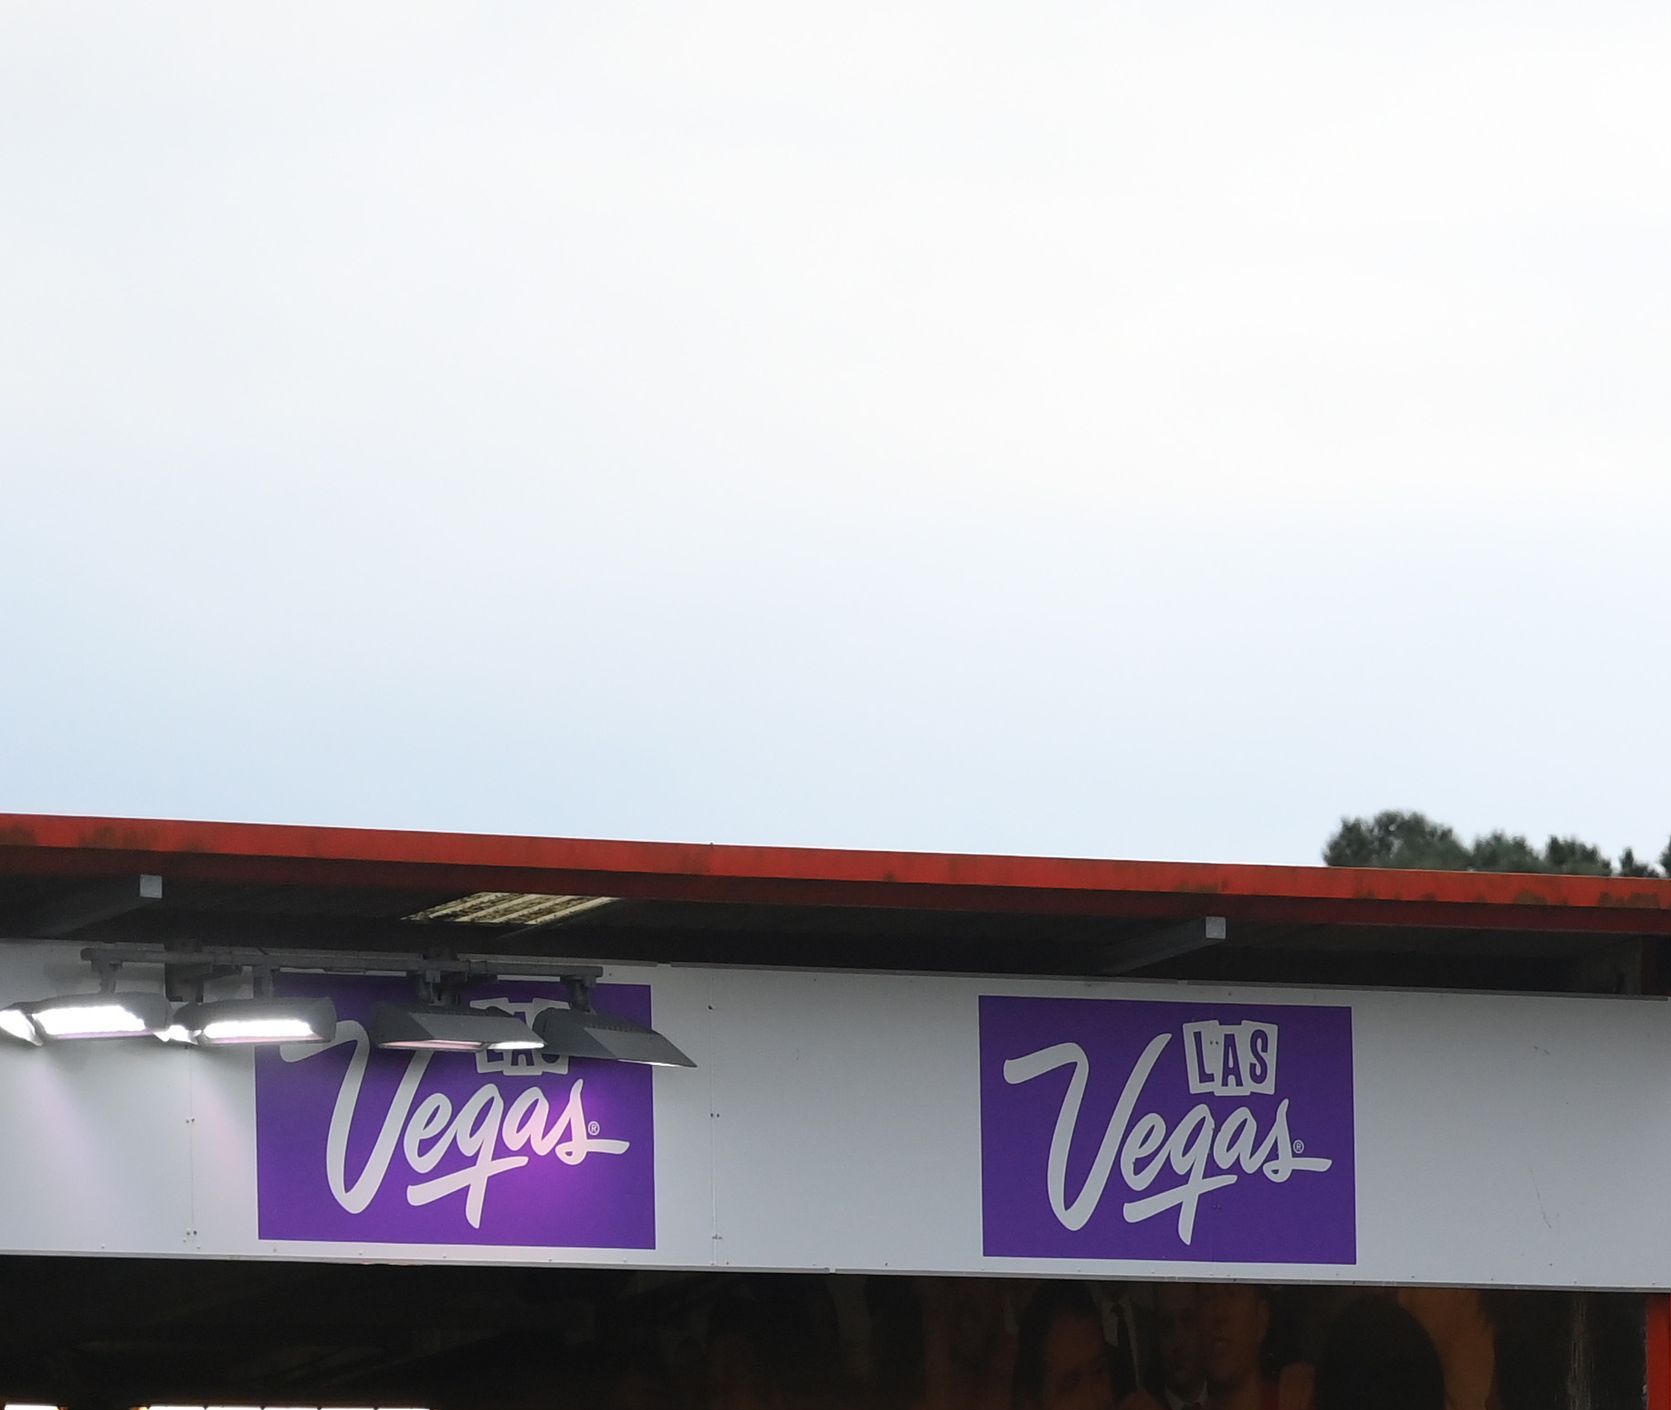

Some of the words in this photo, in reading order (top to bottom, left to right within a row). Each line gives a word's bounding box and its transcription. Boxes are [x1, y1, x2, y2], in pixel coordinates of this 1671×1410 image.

[281, 1019, 630, 1229] Vegas
[1003, 1033, 1332, 1245] Vegas
[1189, 1024, 1273, 1090] LAS
